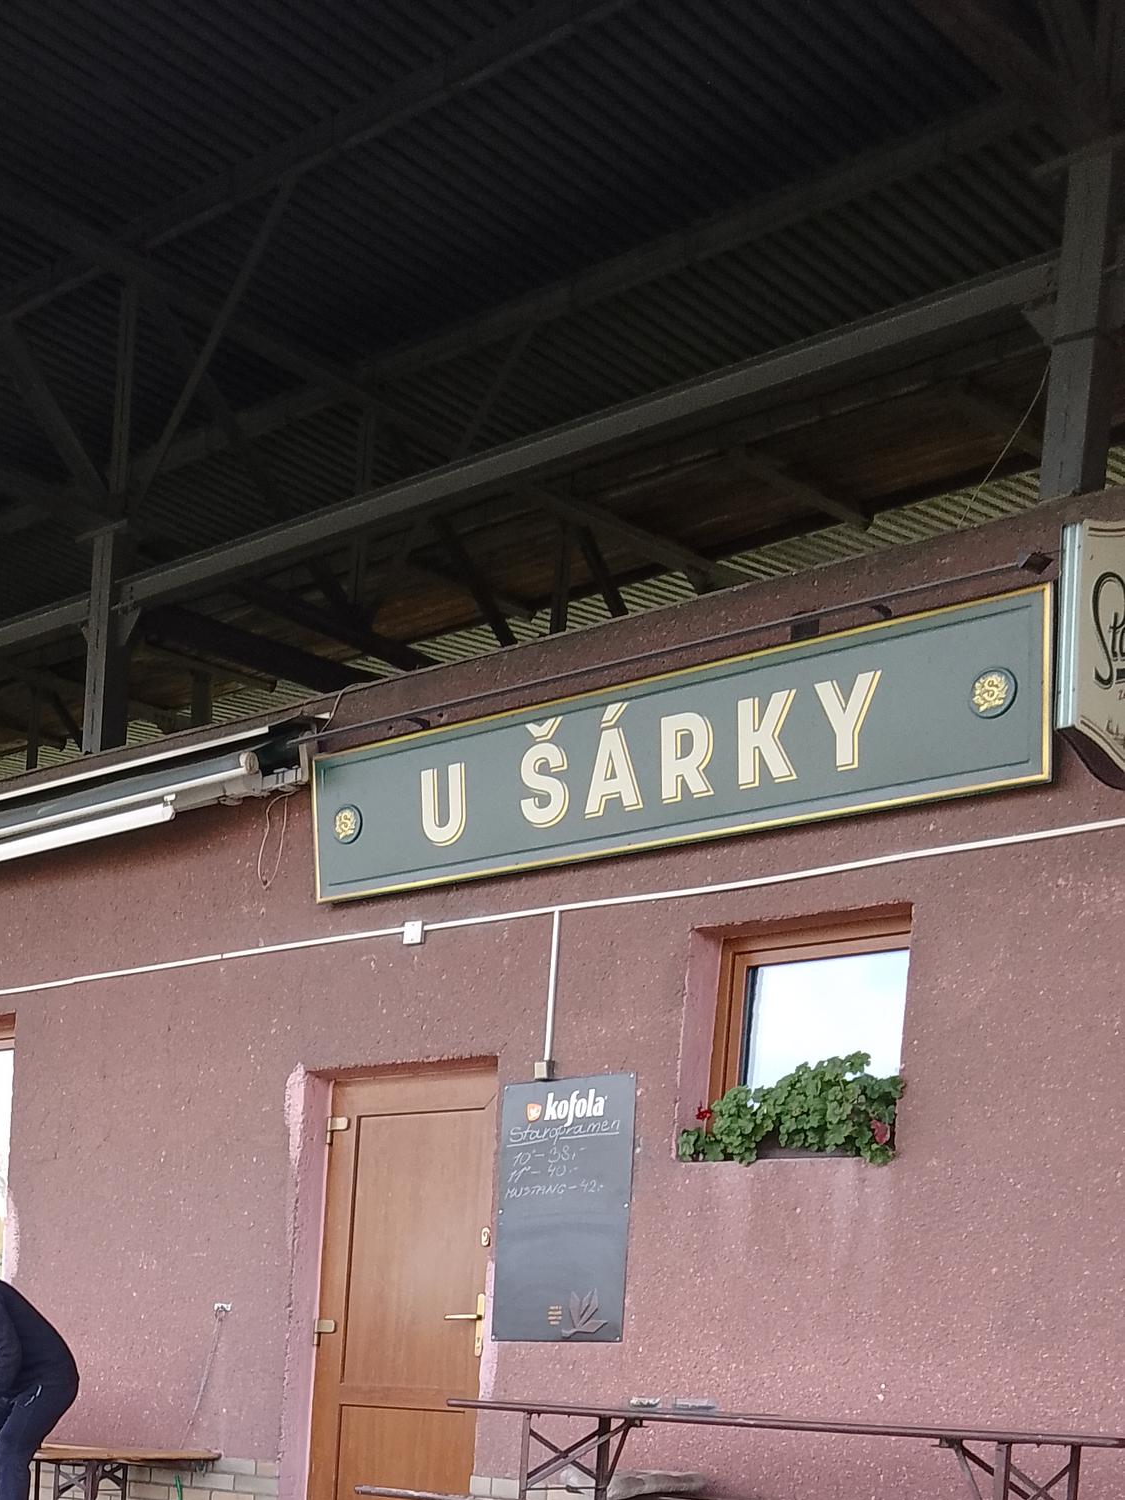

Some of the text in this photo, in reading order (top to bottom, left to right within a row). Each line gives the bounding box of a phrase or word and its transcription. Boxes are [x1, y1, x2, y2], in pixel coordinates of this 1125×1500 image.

[420, 669, 882, 847] U ŠÁRKY
[544, 1089, 606, 1127] kofola
[510, 1120, 620, 1145] Staropramen
[505, 1184, 566, 1199] MUSTANG
